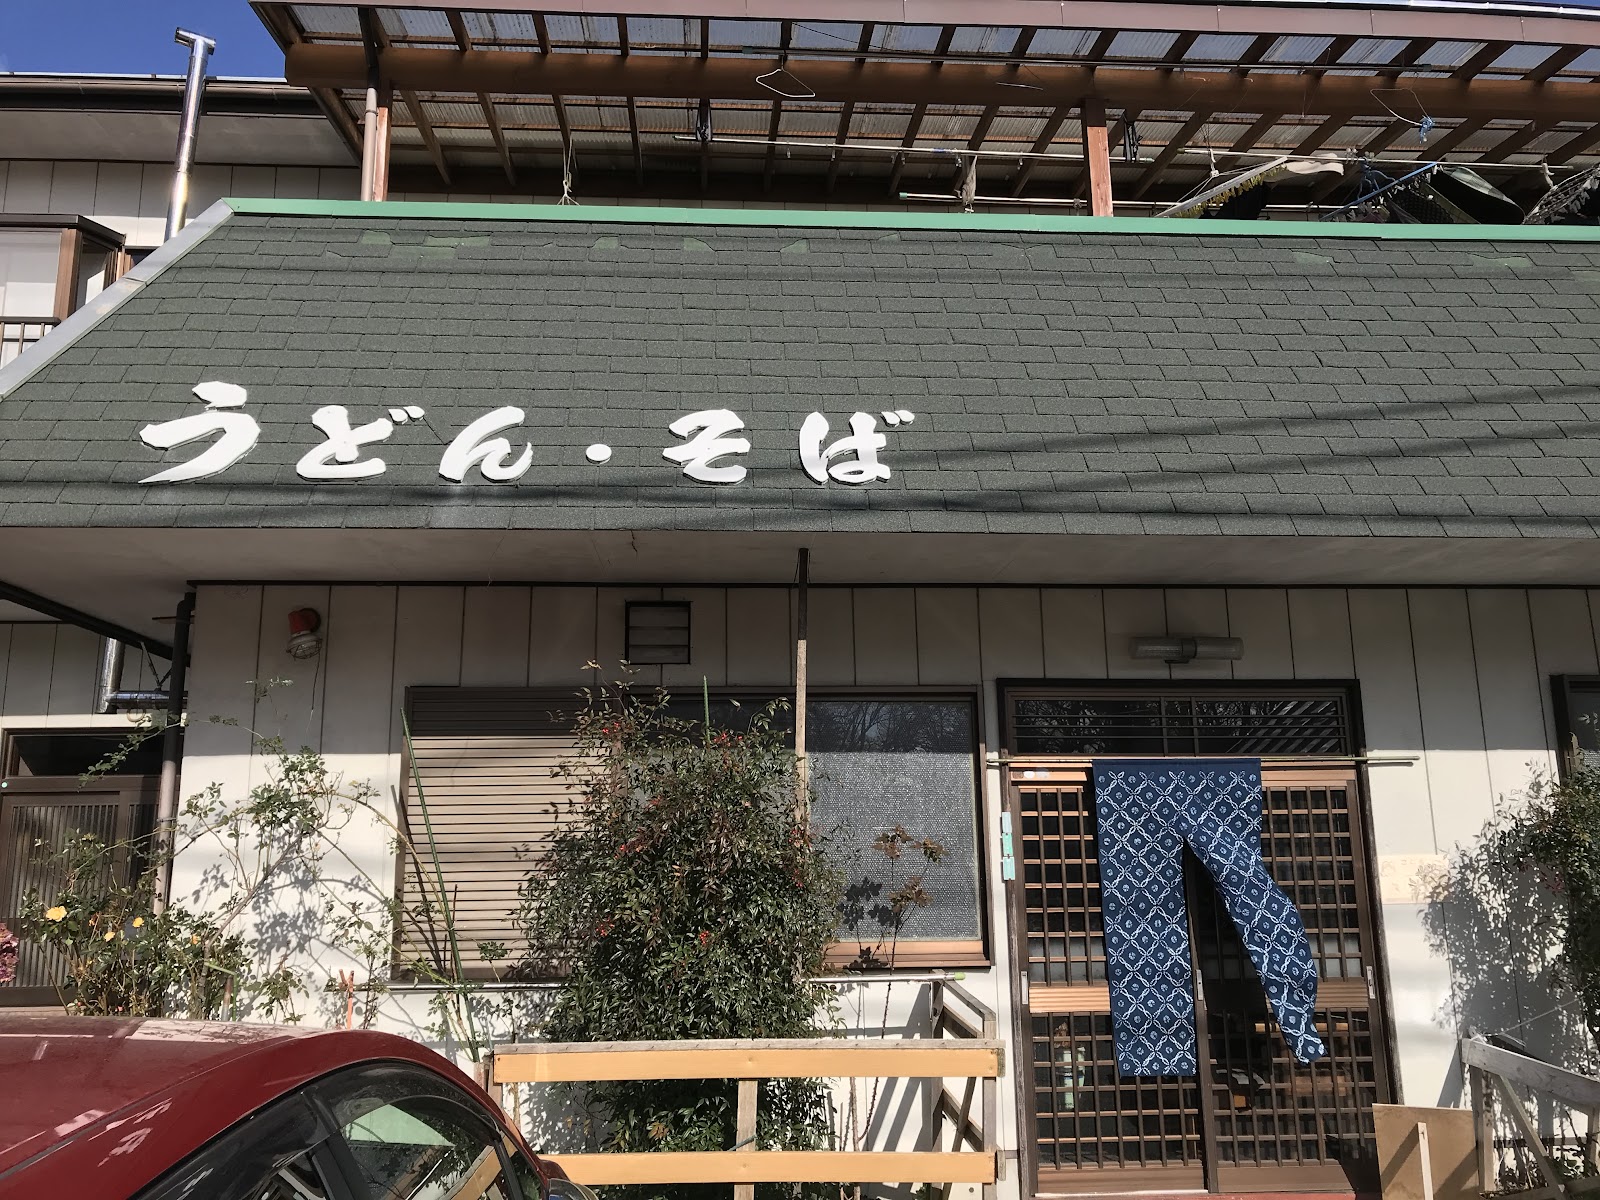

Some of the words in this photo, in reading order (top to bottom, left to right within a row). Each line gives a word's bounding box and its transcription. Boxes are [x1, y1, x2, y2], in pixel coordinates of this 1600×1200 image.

[139, 380, 915, 484] うどん・そば
